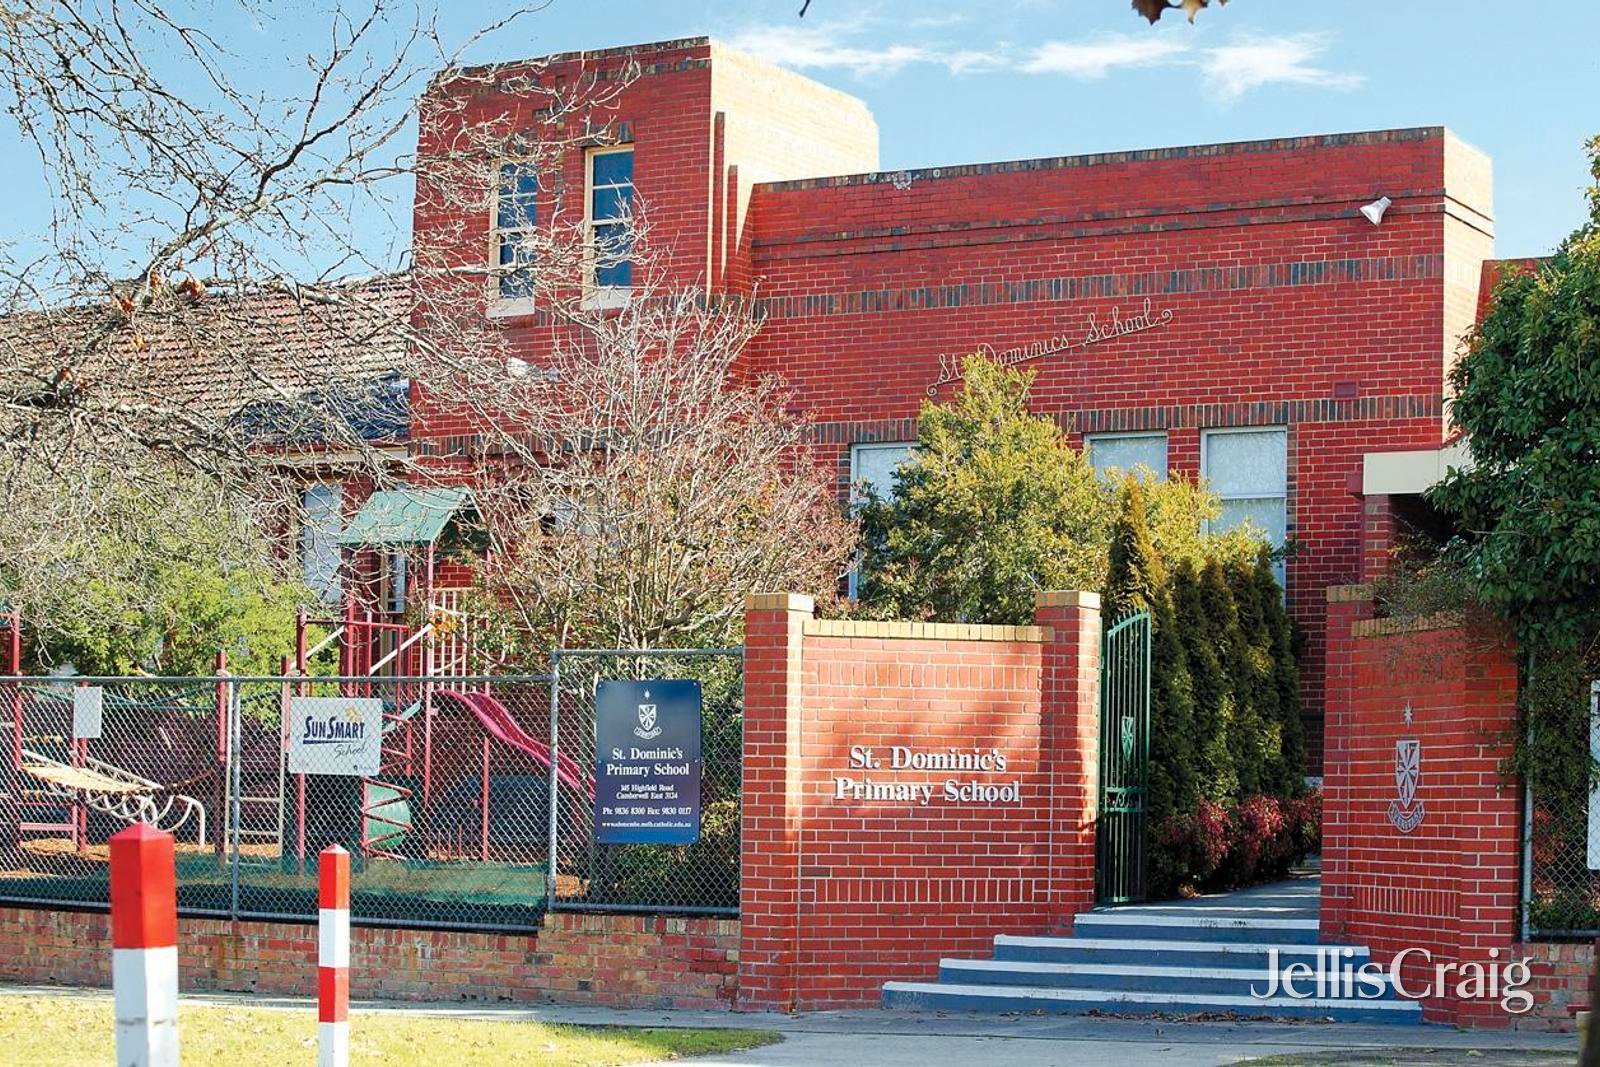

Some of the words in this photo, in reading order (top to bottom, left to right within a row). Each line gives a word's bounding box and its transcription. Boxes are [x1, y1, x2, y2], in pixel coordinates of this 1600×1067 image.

[1081, 297, 1160, 346] School
[612, 747, 626, 760] St.
[630, 747, 683, 760] Dominic's
[850, 745, 880, 769] St.
[891, 745, 1007, 771] Dominic's
[606, 763, 650, 777] Primary
[653, 762, 690, 775] School
[616, 791, 649, 800] Camberwell
[631, 784, 658, 793] Highfield
[658, 784, 674, 792] Road
[834, 777, 934, 805] Primary
[944, 778, 1020, 802] School
